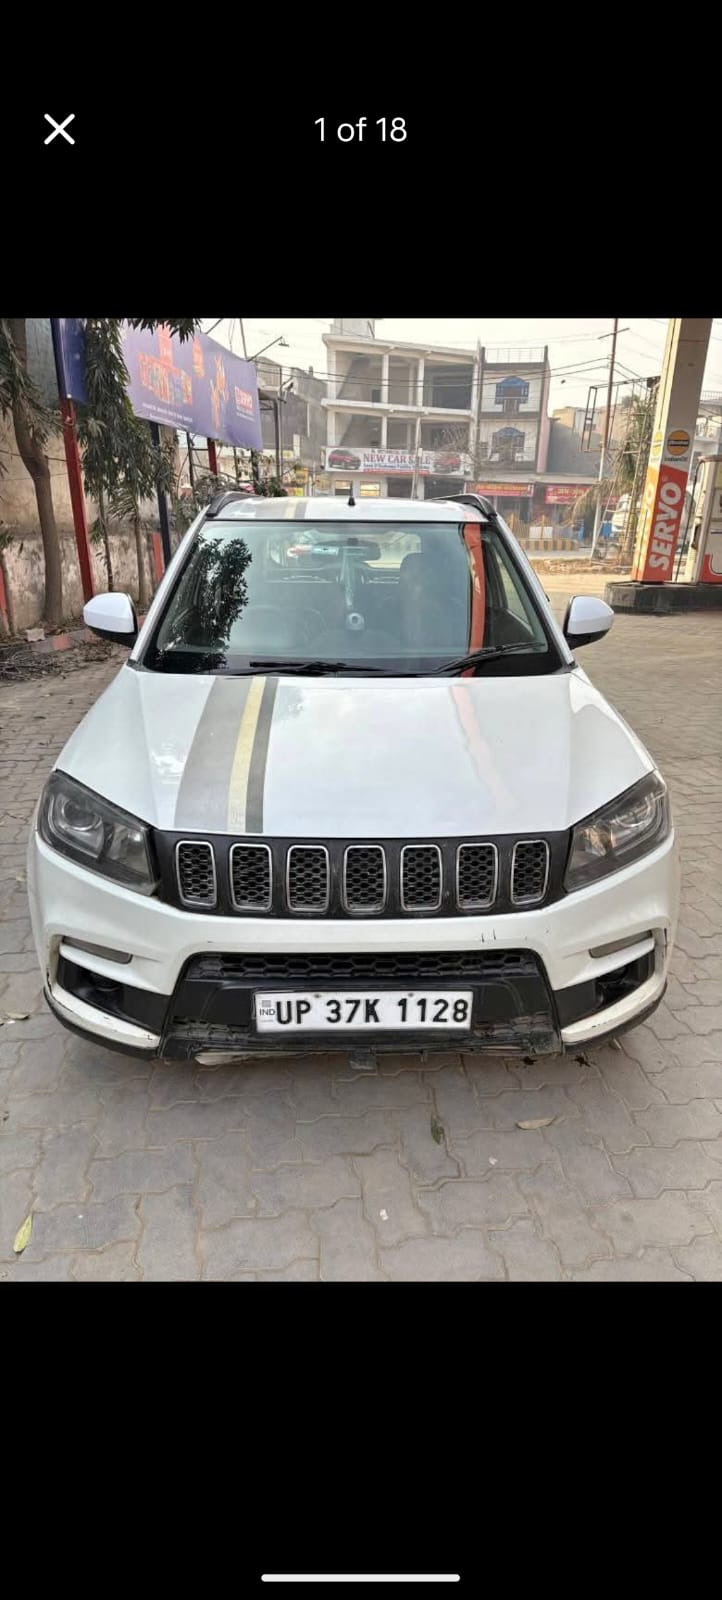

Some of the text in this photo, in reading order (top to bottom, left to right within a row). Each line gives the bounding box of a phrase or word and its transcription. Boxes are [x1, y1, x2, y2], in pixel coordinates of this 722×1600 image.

[363, 453, 431, 465] NEW CAR SLE
[649, 481, 682, 571] SERVO
[259, 1008, 276, 1017] IND
[276, 998, 469, 1025] UP 37K 1128
